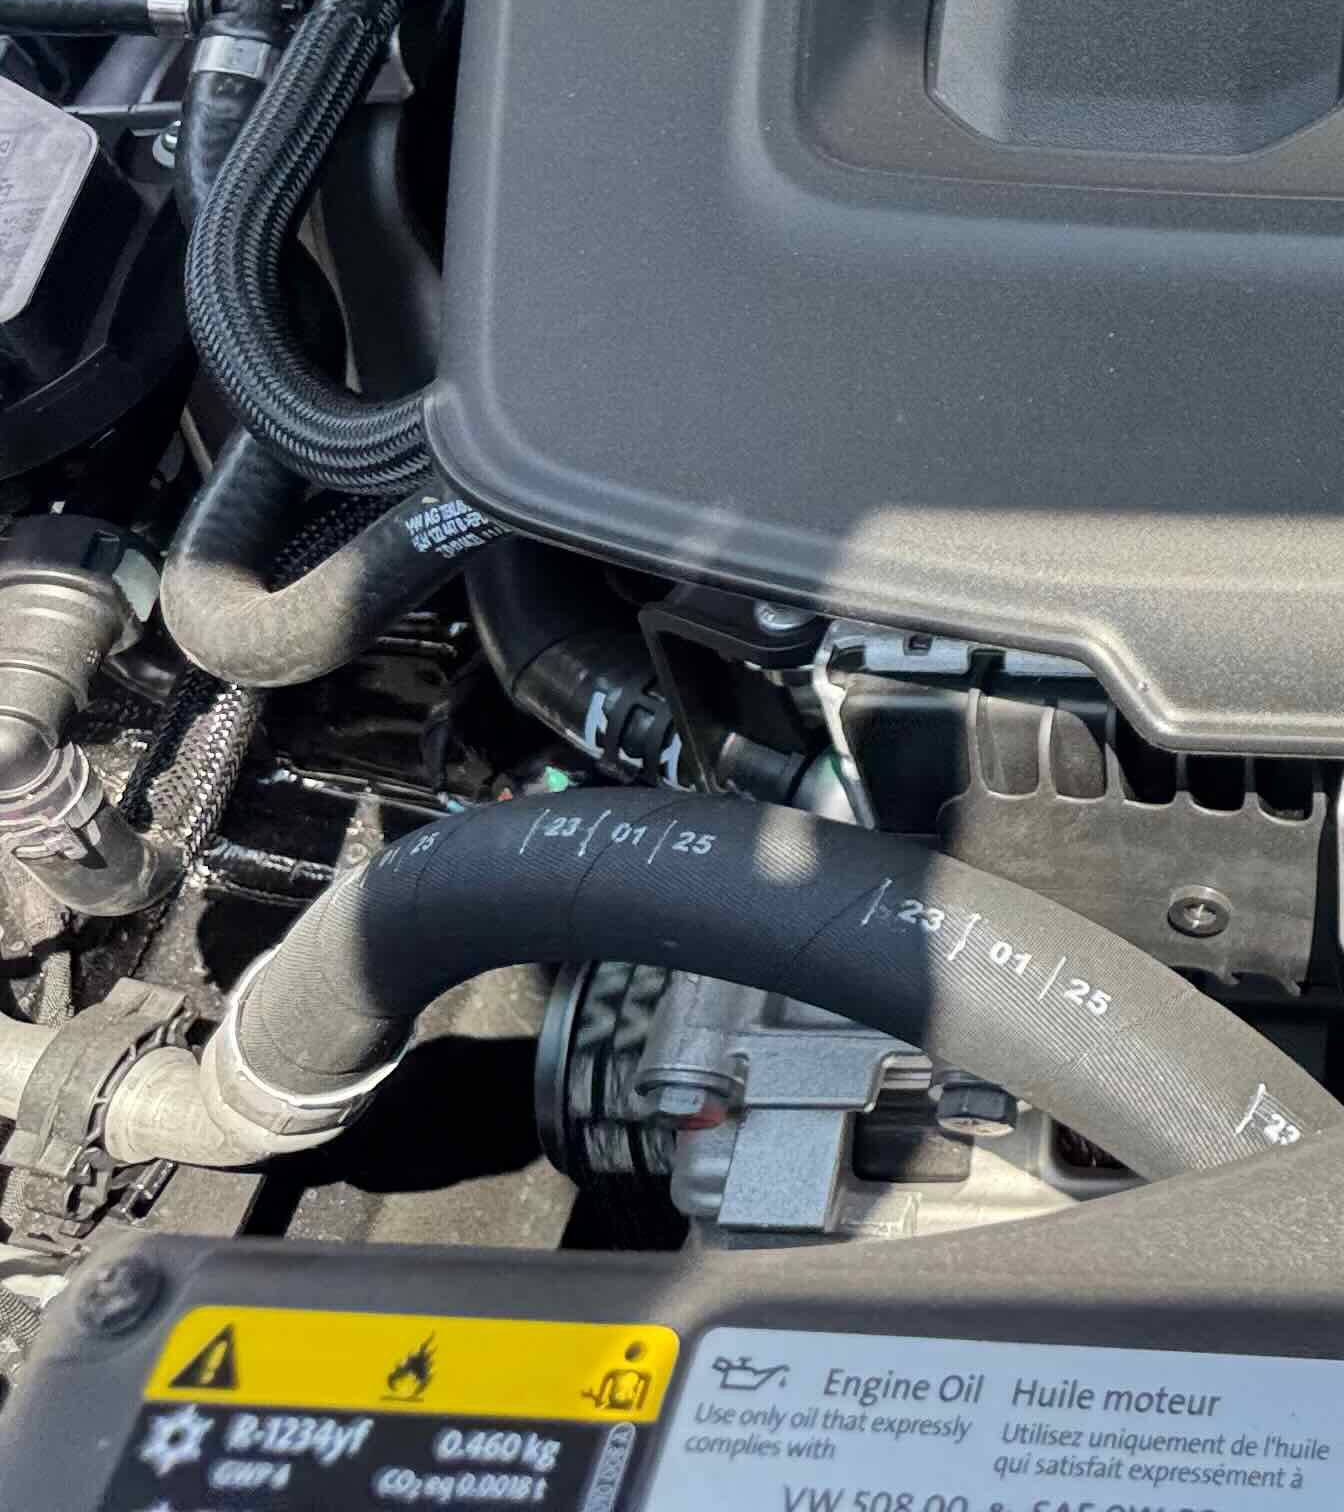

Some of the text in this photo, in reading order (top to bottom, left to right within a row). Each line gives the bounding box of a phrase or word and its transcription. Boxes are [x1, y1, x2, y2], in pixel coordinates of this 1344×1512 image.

[544, 817, 717, 854] 23 01 25
[899, 899, 1111, 1016] 23 01 25
[822, 1368, 985, 1406] Engine Oil
[1011, 1377, 1221, 1416] Huile moteur
[694, 1402, 973, 1443] Use only oil that expressly
[1001, 1422, 1331, 1461] Utilisez uniquement de l'huile
[225, 1413, 375, 1466] R-1234yf
[435, 1428, 523, 1462] 0.460
[522, 1432, 561, 1473] kg
[684, 1434, 836, 1461] complies with
[993, 1453, 1304, 1489] qui satisfait expressément à
[783, 1485, 844, 1512] VW
[853, 1490, 914, 1512] 508
